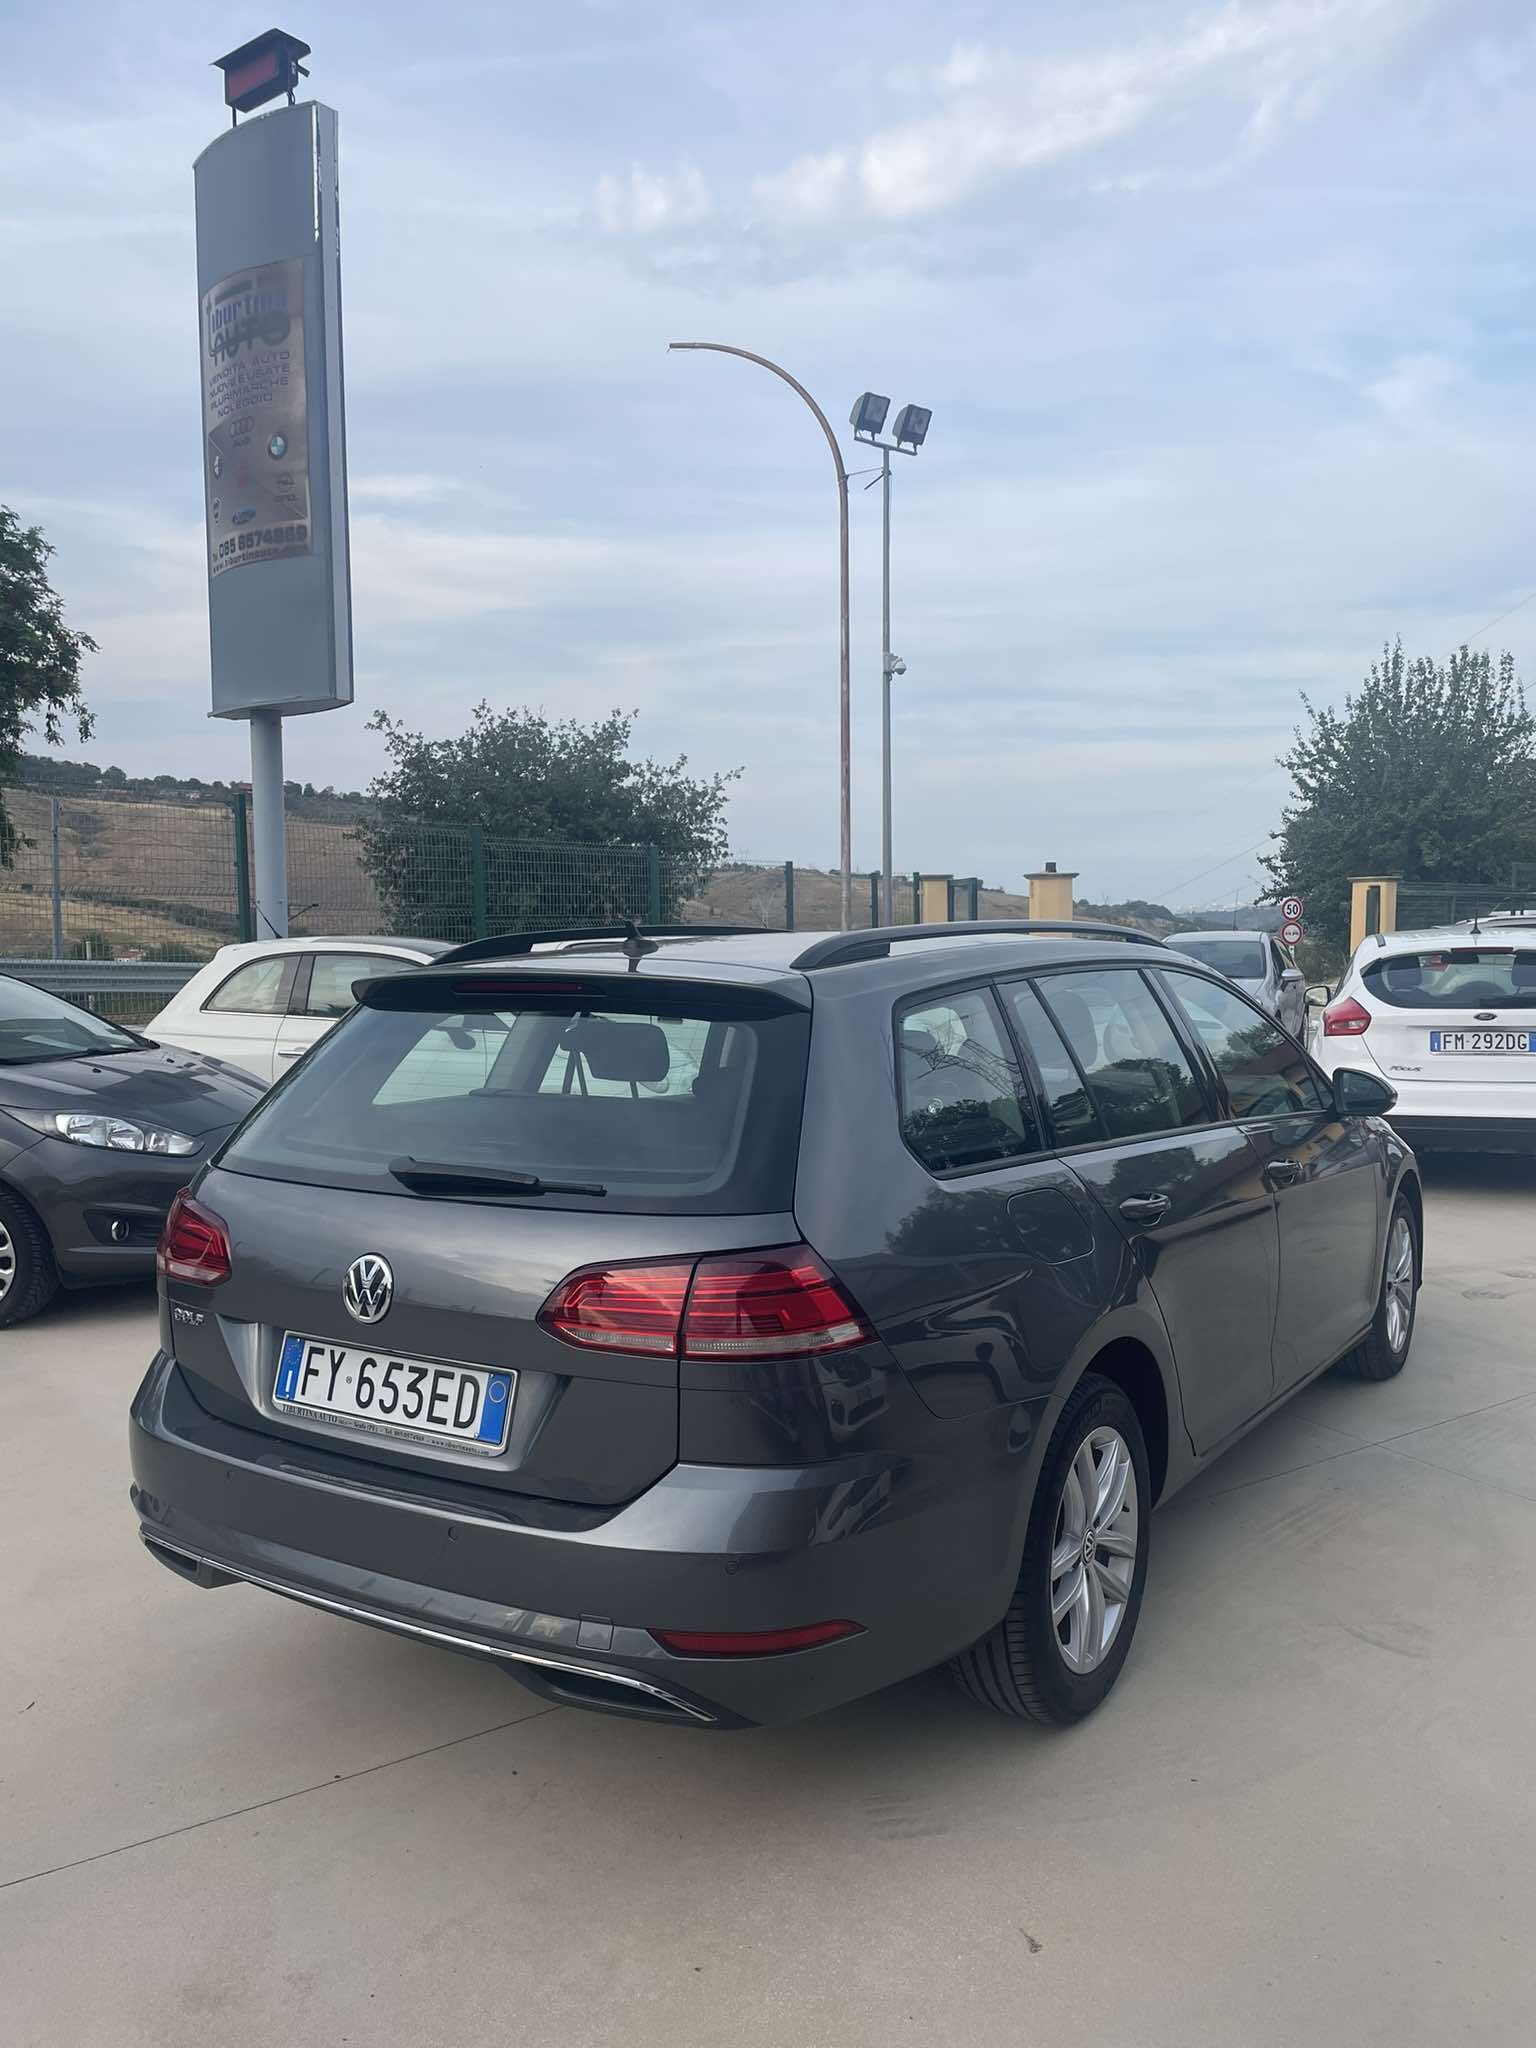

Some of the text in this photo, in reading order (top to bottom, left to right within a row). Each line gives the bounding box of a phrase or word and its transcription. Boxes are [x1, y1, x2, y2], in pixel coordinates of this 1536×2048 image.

[255, 351, 290, 366] AUTO
[1286, 904, 1299, 915] 50
[1443, 1034, 1527, 1050] FM 292DG
[300, 1346, 480, 1430] FY 653ED
[318, 1411, 338, 1424] AUTO
